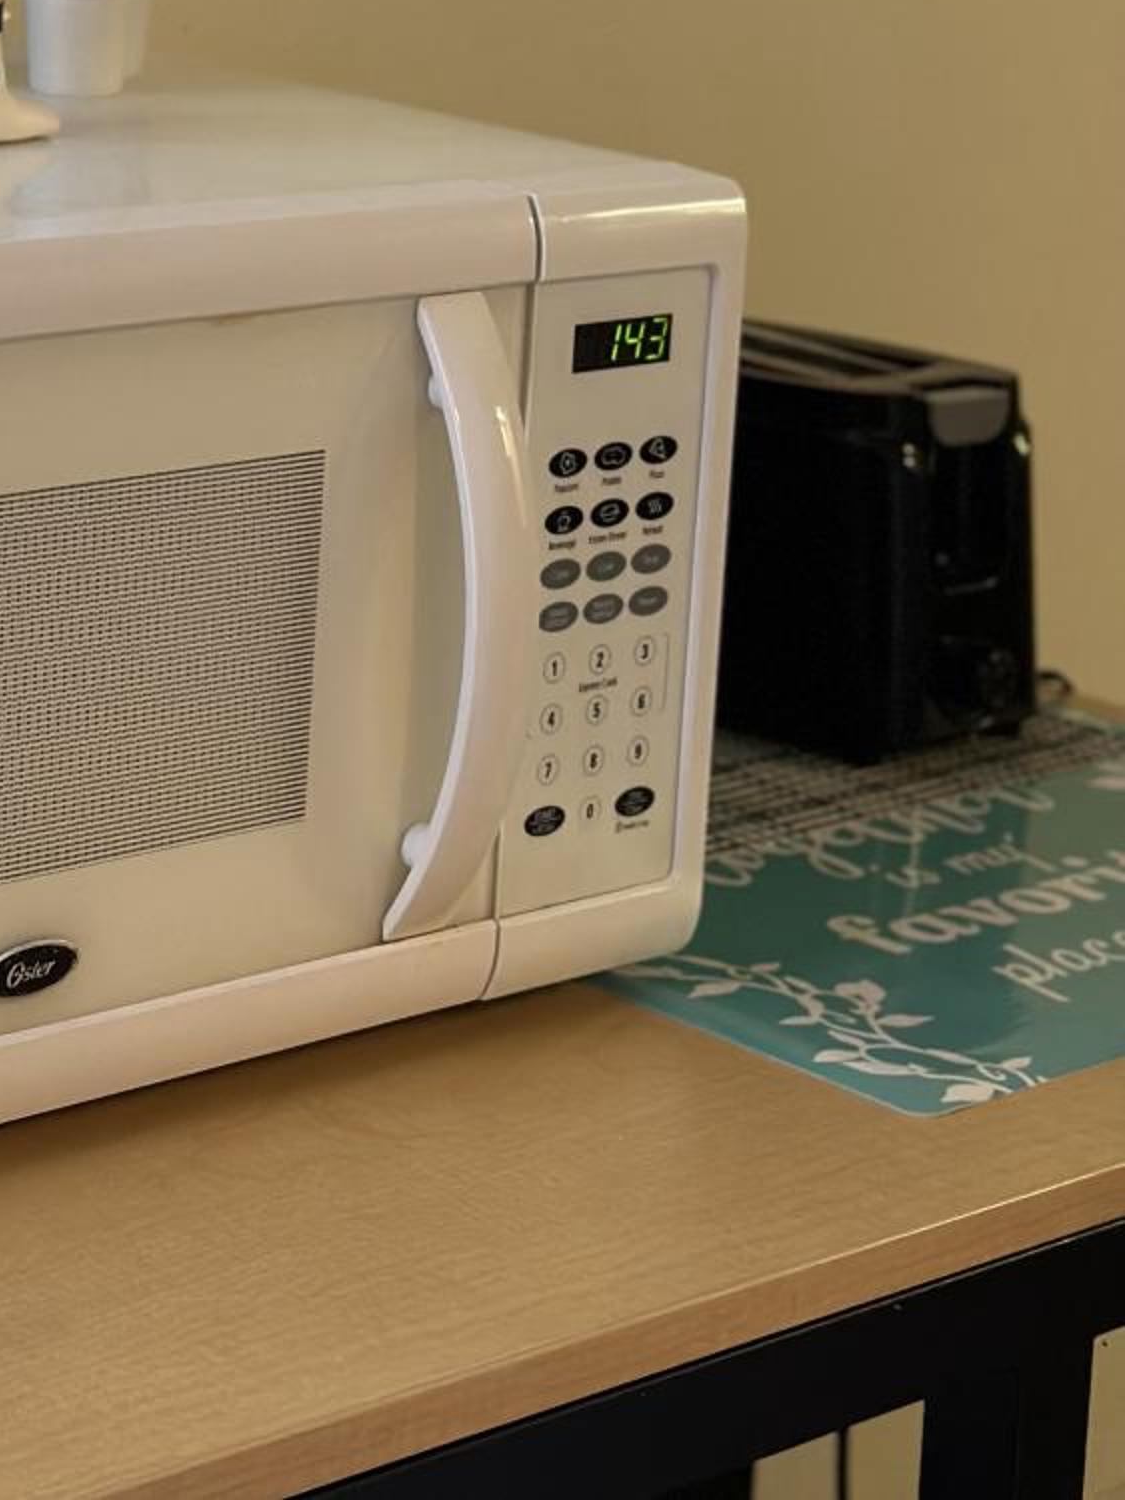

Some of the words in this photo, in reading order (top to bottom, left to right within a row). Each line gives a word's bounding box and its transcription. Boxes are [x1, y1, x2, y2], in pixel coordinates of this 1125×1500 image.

[595, 651, 604, 668] 2
[640, 643, 649, 660] 3
[551, 659, 558, 676] 1
[547, 710, 555, 726] 4
[592, 701, 601, 718] 5
[545, 761, 552, 779] 7
[586, 803, 594, 819] 0
[827, 850, 1125, 954] favori
